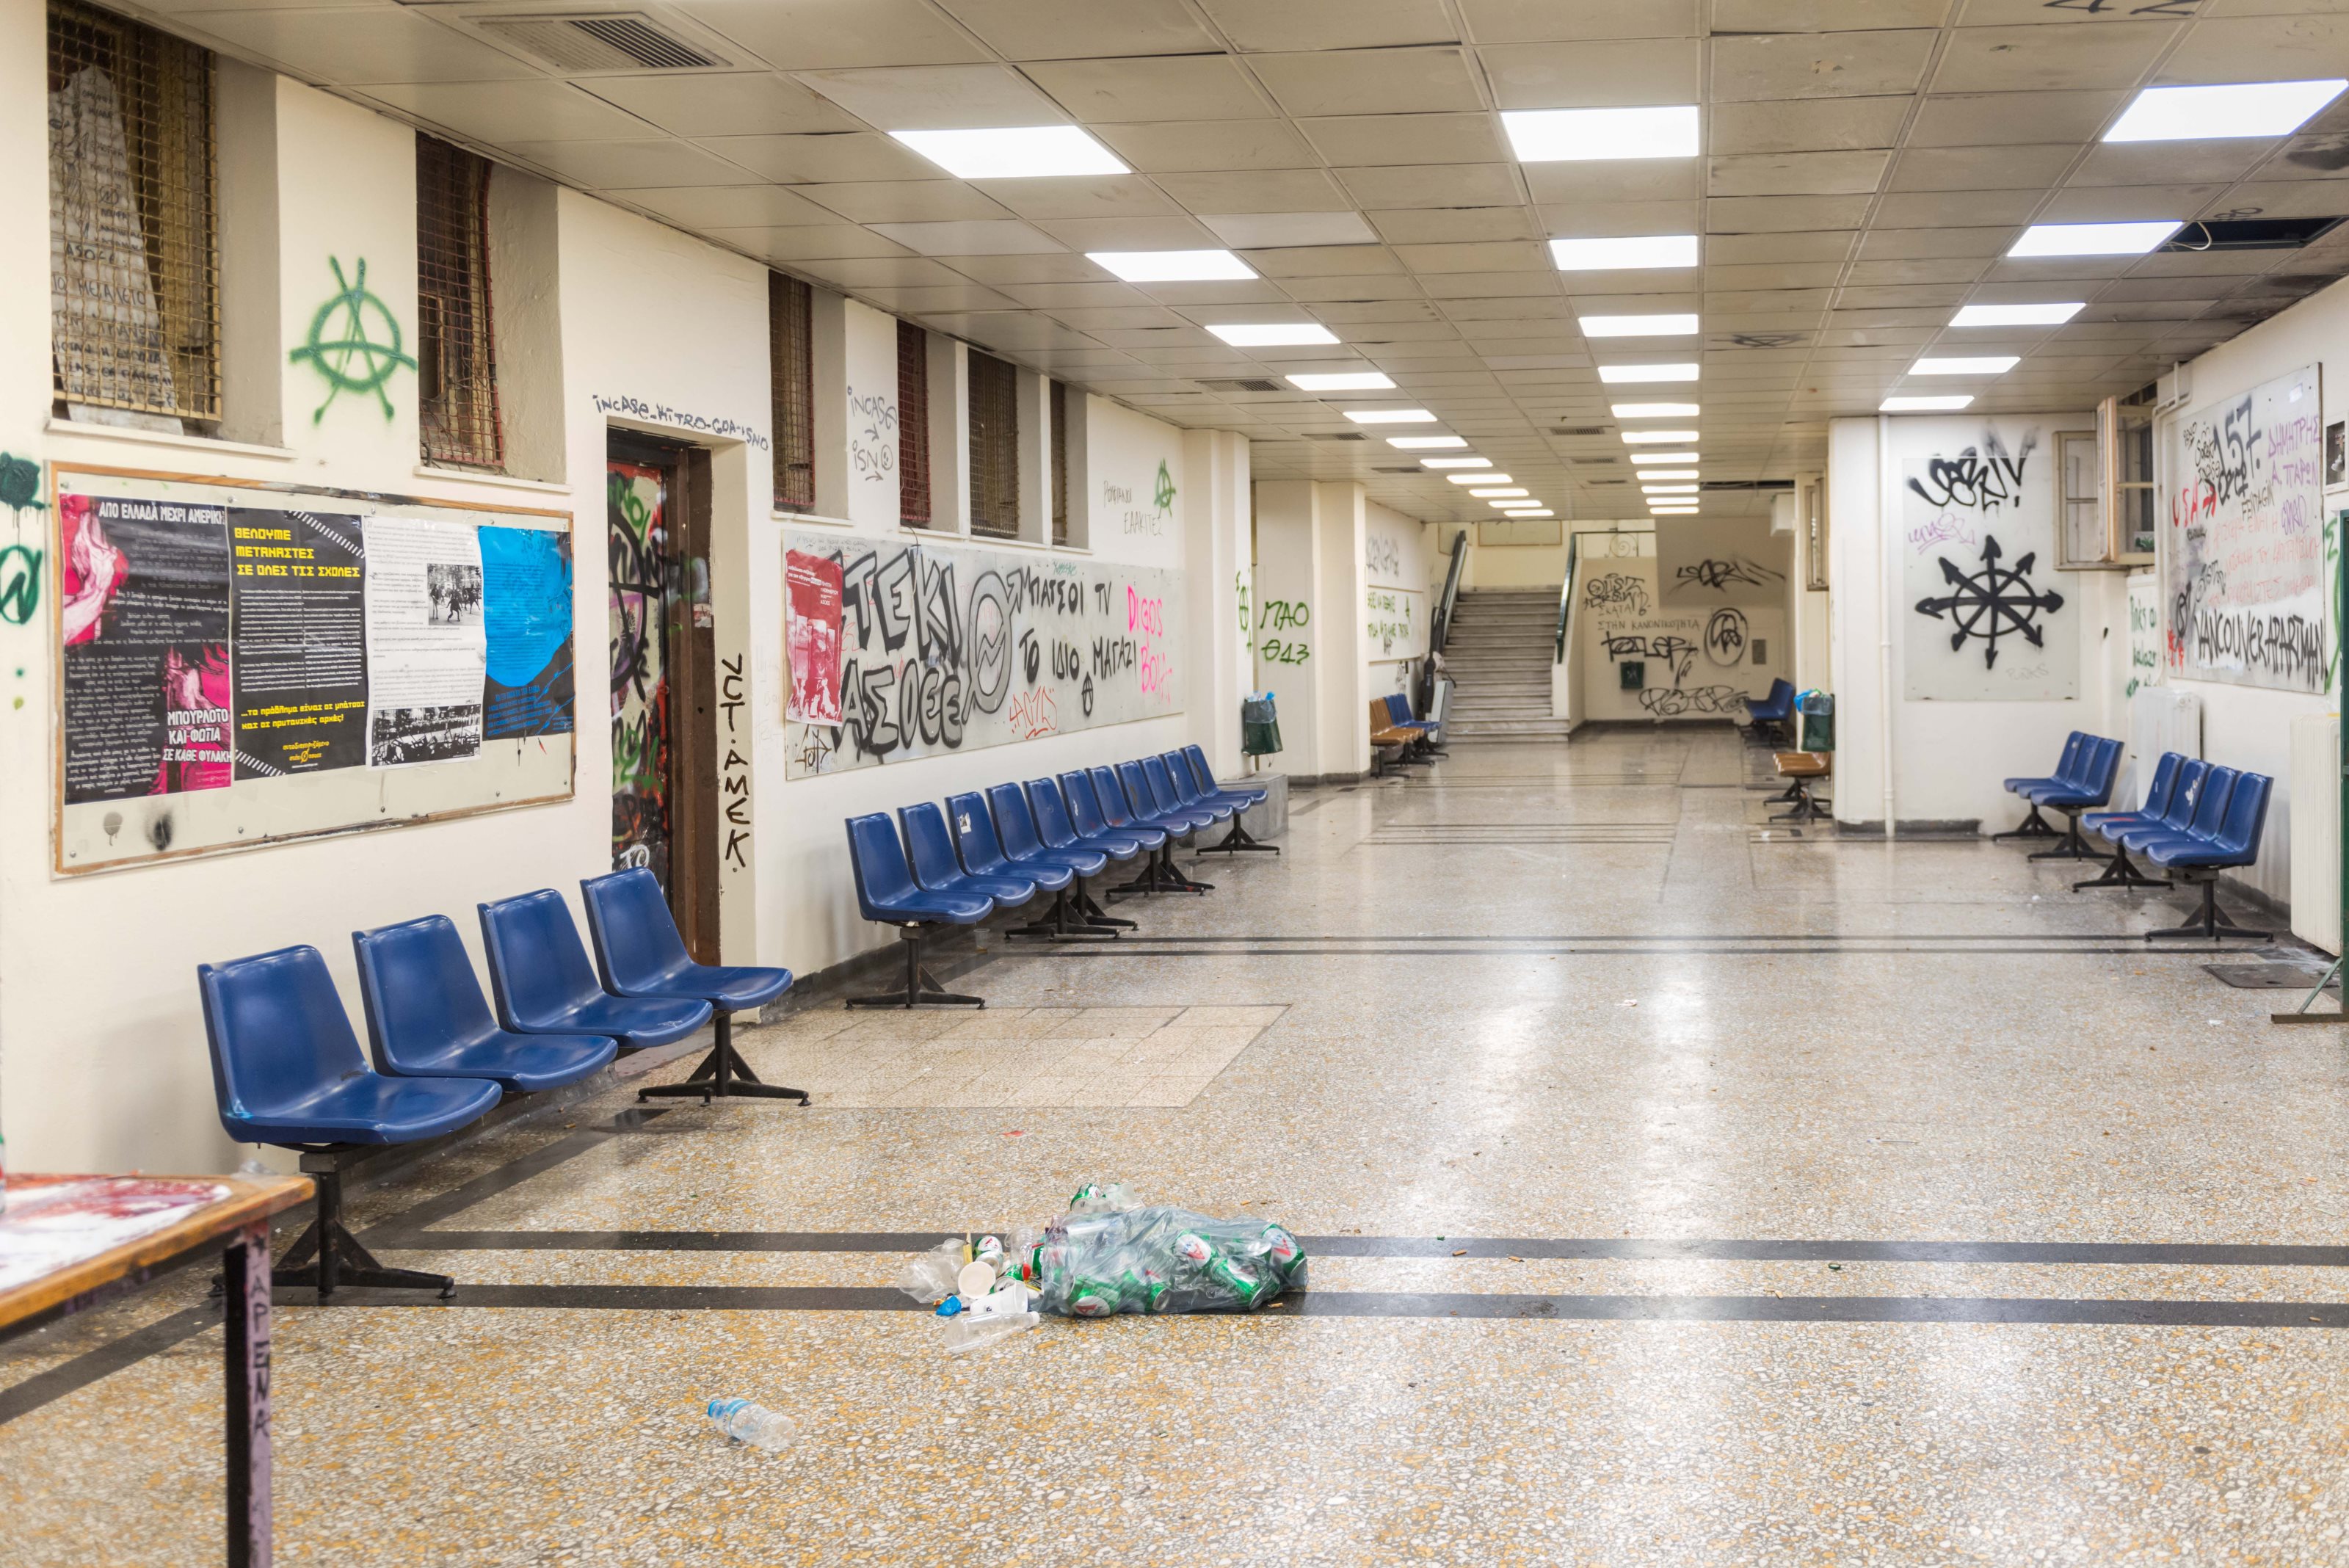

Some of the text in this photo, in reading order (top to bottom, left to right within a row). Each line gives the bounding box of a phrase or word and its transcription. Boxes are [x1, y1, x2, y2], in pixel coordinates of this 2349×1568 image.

[98, 502, 119, 518] ΑΠΟ
[121, 504, 159, 521] ΕΛΛΑΔΑ
[160, 506, 186, 523] ΜΕΧΡΙ
[234, 527, 291, 541] ΘΕΛΟΥΜΕ
[235, 545, 315, 559] ΜΕΤΑΝΑΣΤΕΣ
[236, 564, 361, 578] ΣΕ ΟΛΕΣ ΤΙΣ ΣΧΟΛΕΣ
[827, 548, 964, 669] ΤΕΚΙ
[1018, 628, 1040, 683] ΤΟ
[1052, 638, 1080, 680] ΙΔΙΟ
[167, 708, 229, 726] ΜΠΟΥΡΛΟΤΟ
[242, 721, 259, 730] και
[168, 727, 221, 745] ΚΑΙ ΦΩΤΙΑ
[162, 749, 232, 763] ΣΕ ΚΑΘΕ ΦΥΛΑΚΗ
